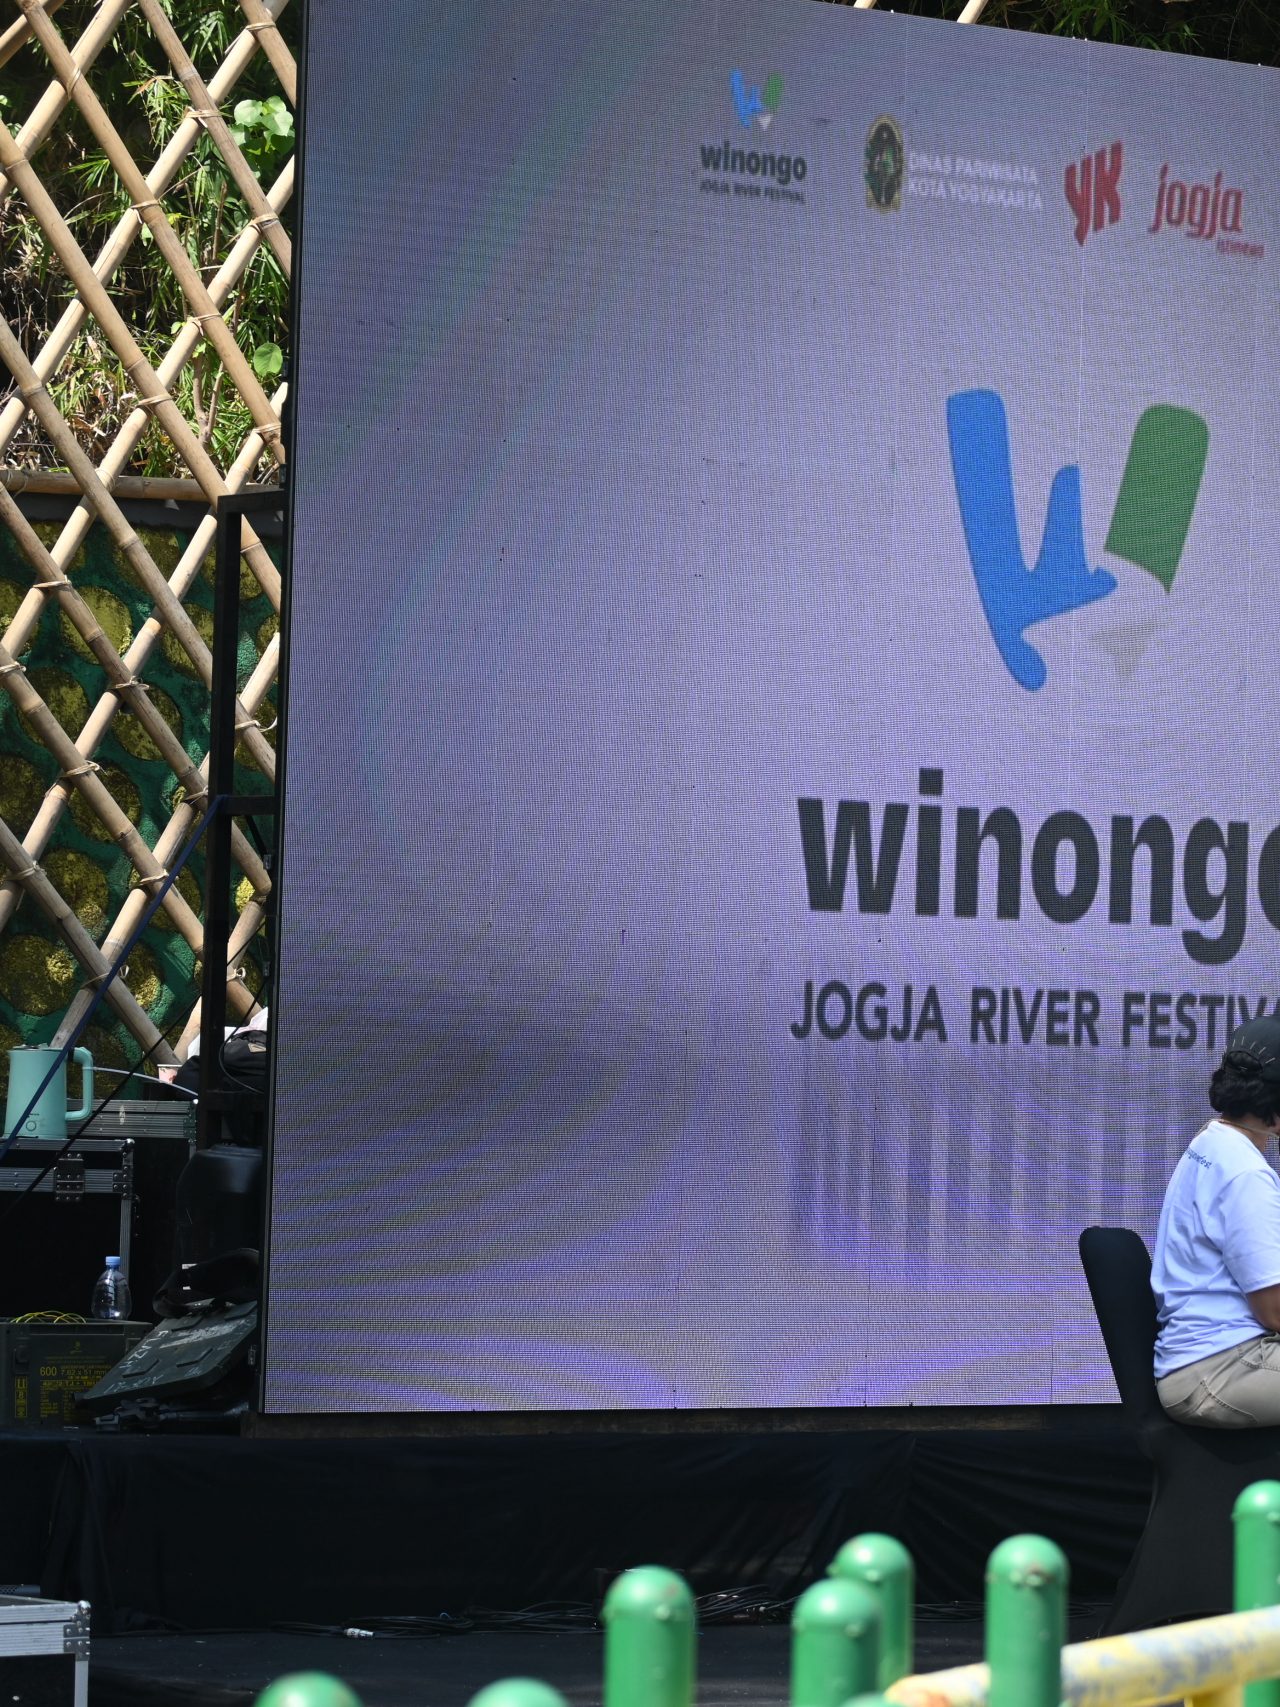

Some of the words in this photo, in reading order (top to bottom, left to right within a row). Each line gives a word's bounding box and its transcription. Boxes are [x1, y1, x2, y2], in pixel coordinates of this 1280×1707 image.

[700, 141, 807, 186] winongo
[1149, 163, 1245, 239] jogja
[789, 979, 949, 1043] JOGJA
[969, 986, 1100, 1046] RIVER
[40, 1366, 57, 1376] 600
